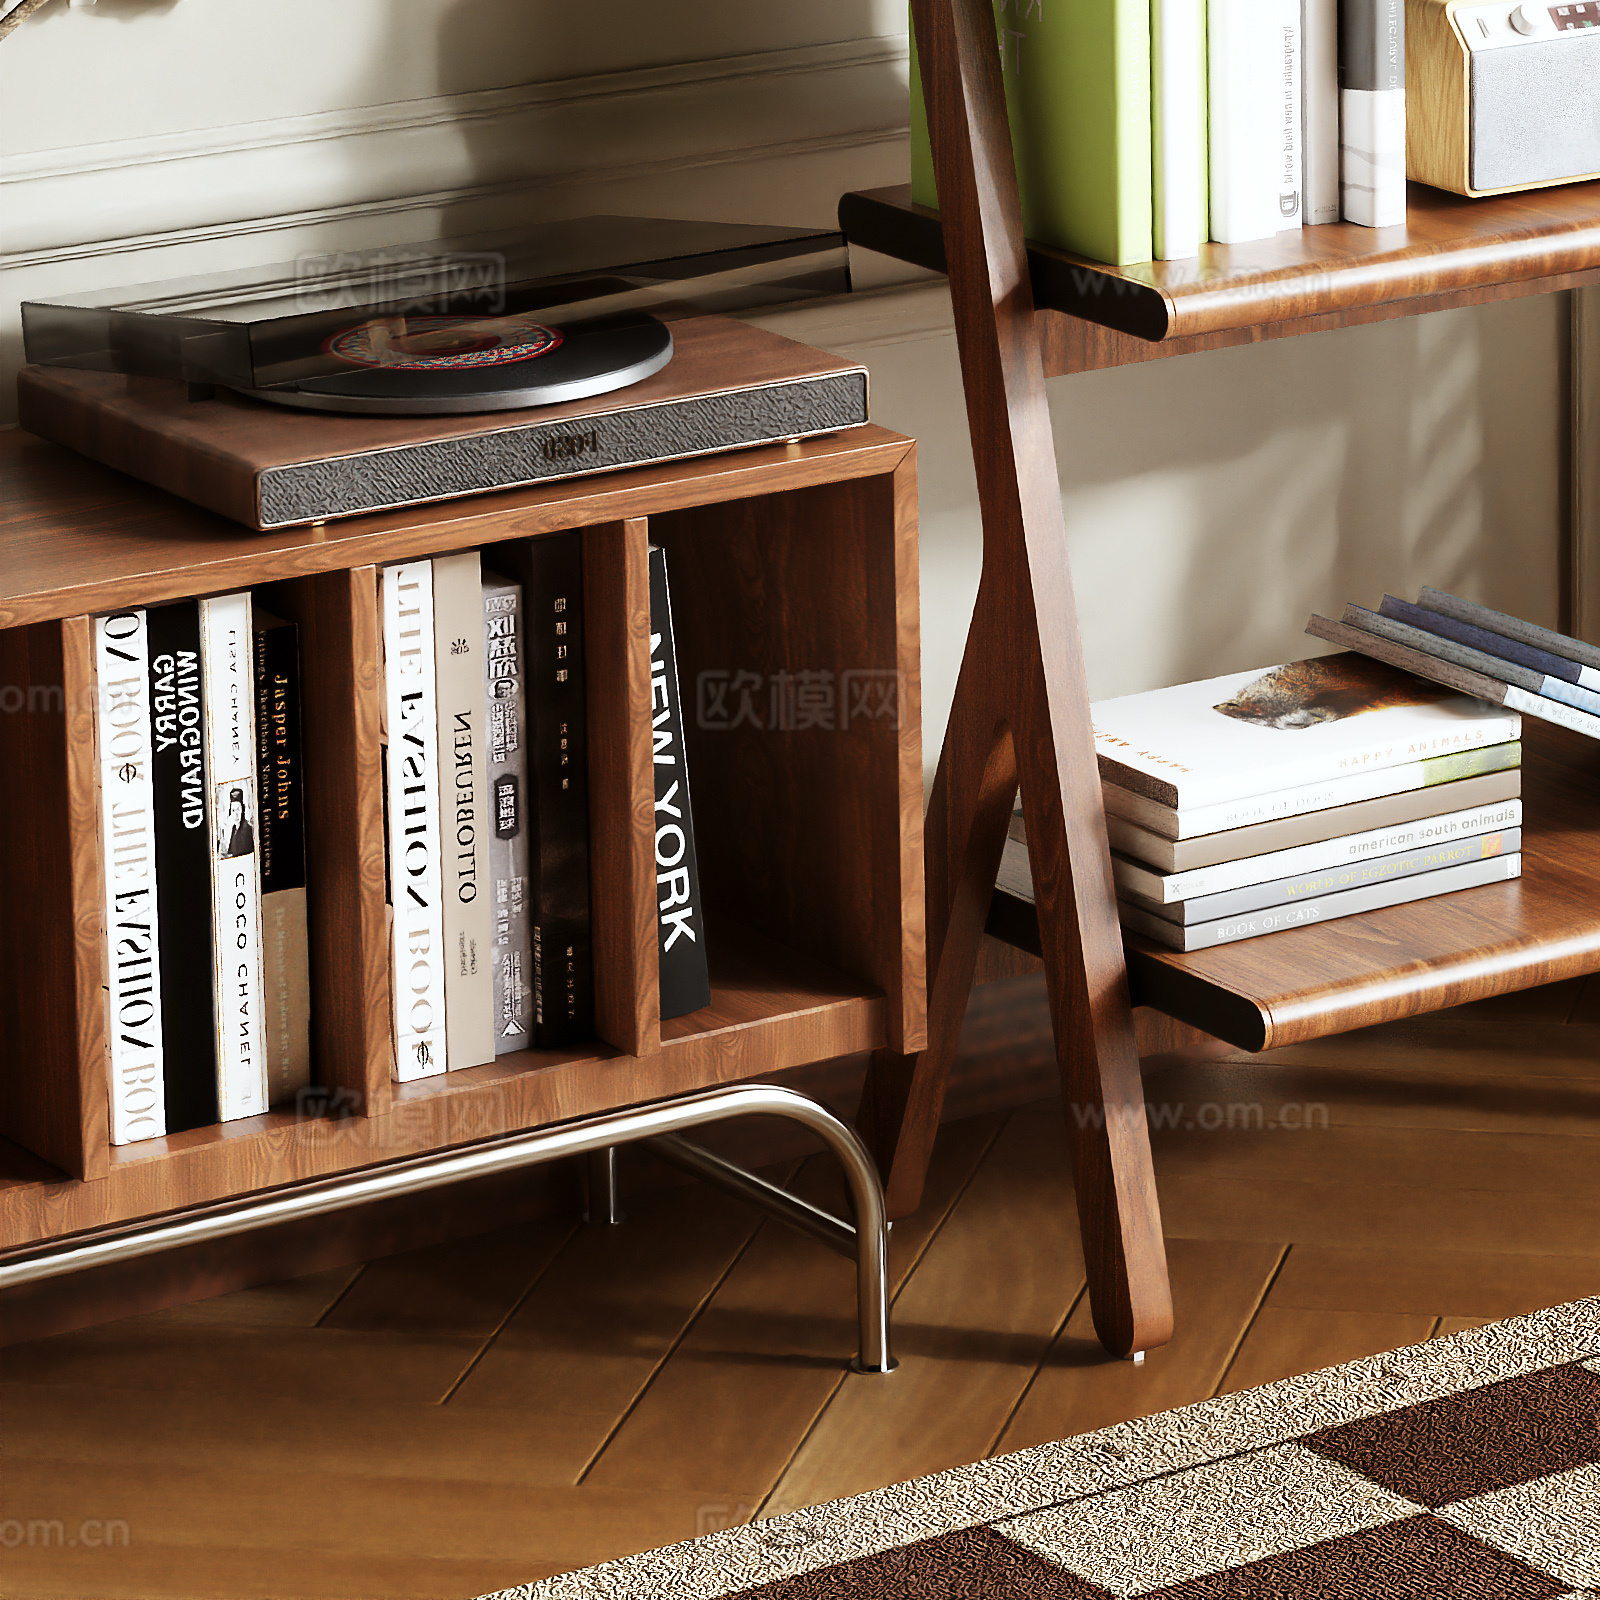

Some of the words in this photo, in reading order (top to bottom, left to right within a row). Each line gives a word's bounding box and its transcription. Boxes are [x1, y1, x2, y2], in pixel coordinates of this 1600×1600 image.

[259, 688, 271, 759] Sketchbook
[271, 675, 288, 748] Jasper
[1339, 747, 1393, 769] HAPPY
[1407, 728, 1484, 755] ANIMALS
[276, 756, 291, 820] Johns
[1348, 831, 1414, 855] american
[1418, 820, 1458, 841] south
[1461, 808, 1516, 831] animals
[652, 781, 697, 953] YORK
[1286, 877, 1335, 898] WORLD
[1338, 870, 1358, 886] OF
[1361, 857, 1420, 881] EGZOTIC
[1423, 844, 1474, 868] PARROT
[1217, 921, 1257, 940] BOOK
[1261, 915, 1282, 931] OF
[1285, 905, 1320, 924] CATS
